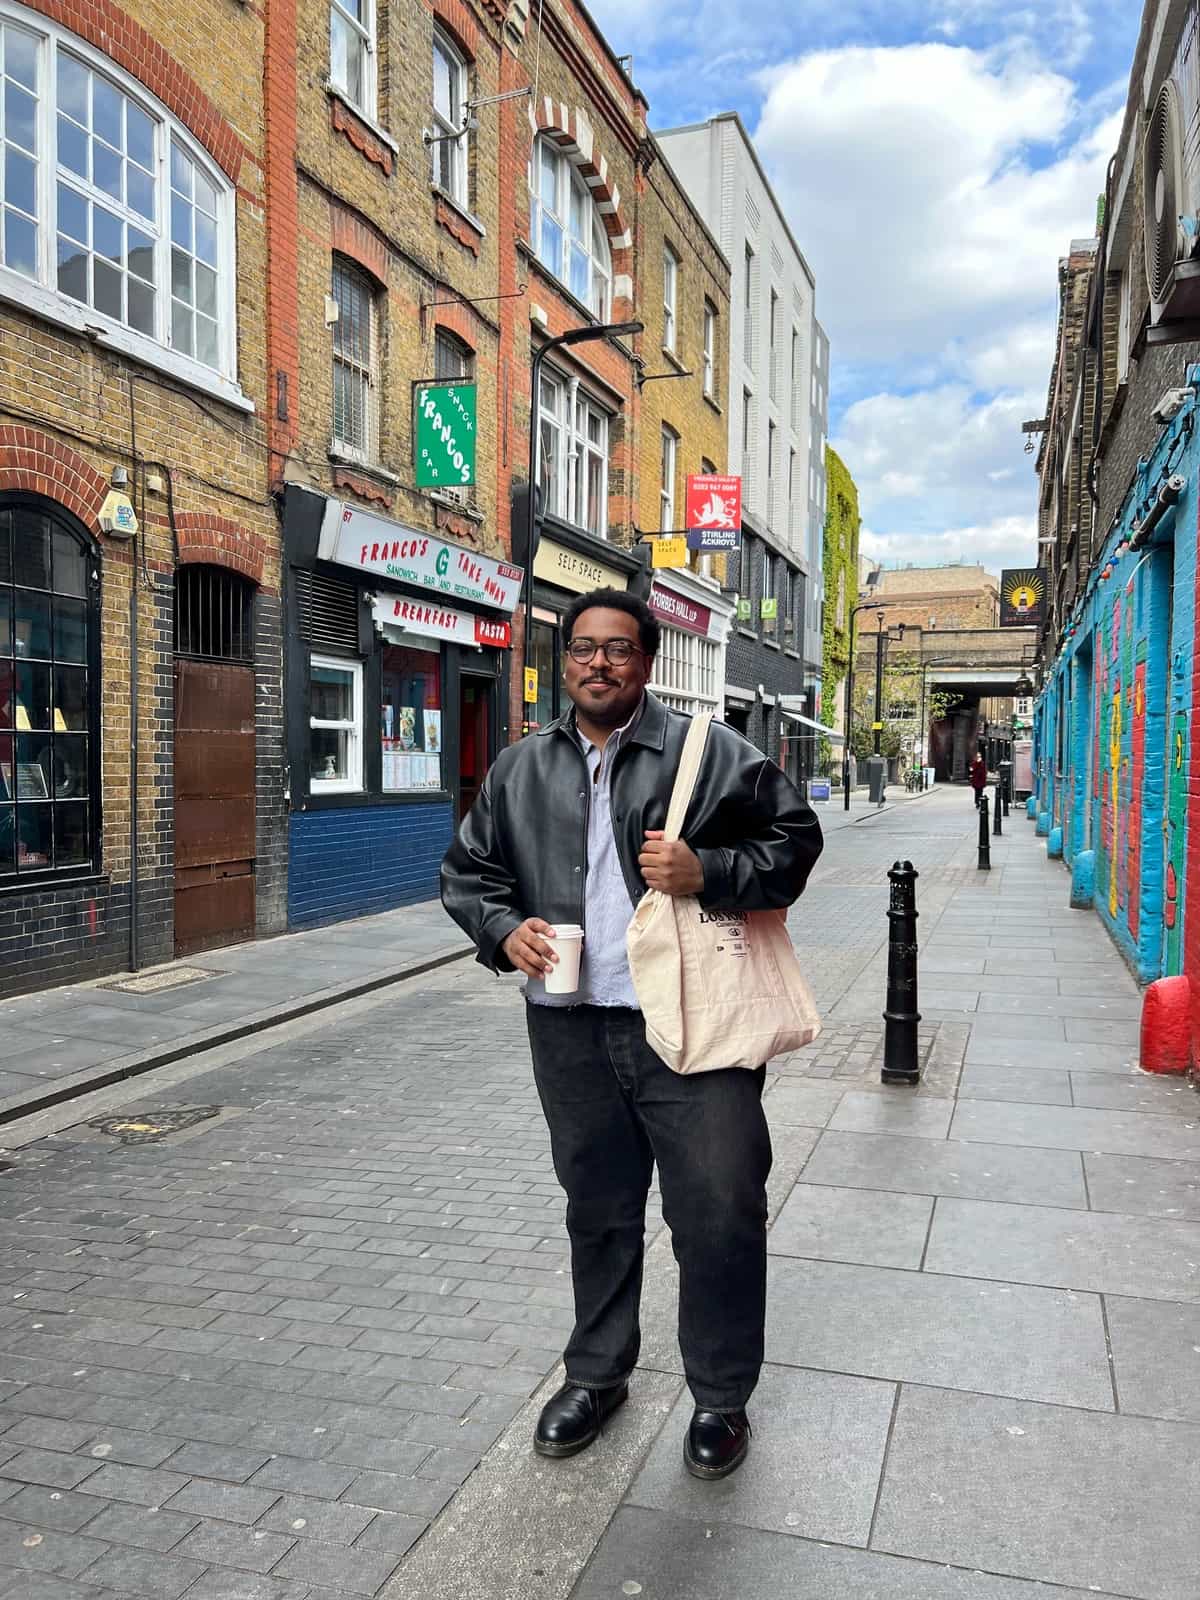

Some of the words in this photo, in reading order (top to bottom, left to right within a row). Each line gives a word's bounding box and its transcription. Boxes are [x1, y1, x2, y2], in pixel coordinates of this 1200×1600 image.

[447, 388, 473, 431] SNACK
[420, 389, 471, 482] FRANCOS
[421, 448, 439, 478] BAR
[343, 510, 353, 523] 67
[701, 530, 736, 539] STIRLING
[701, 538, 736, 547] ACKROYD
[361, 539, 429, 564] FRANCO'S
[435, 547, 450, 576] G
[457, 552, 482, 583] TAKE
[483, 576, 507, 604] AWAY
[385, 563, 418, 582] SANDWICH
[423, 574, 435, 586] BAR
[440, 579, 451, 591] AND
[454, 583, 486, 600] RESTAURANT
[557, 552, 577, 573] SELF
[579, 561, 603, 583] SPACE
[394, 600, 458, 629] BREAKFAST
[480, 620, 506, 641] PASTA
[653, 590, 675, 615] FORBES
[675, 600, 689, 620] HALL
